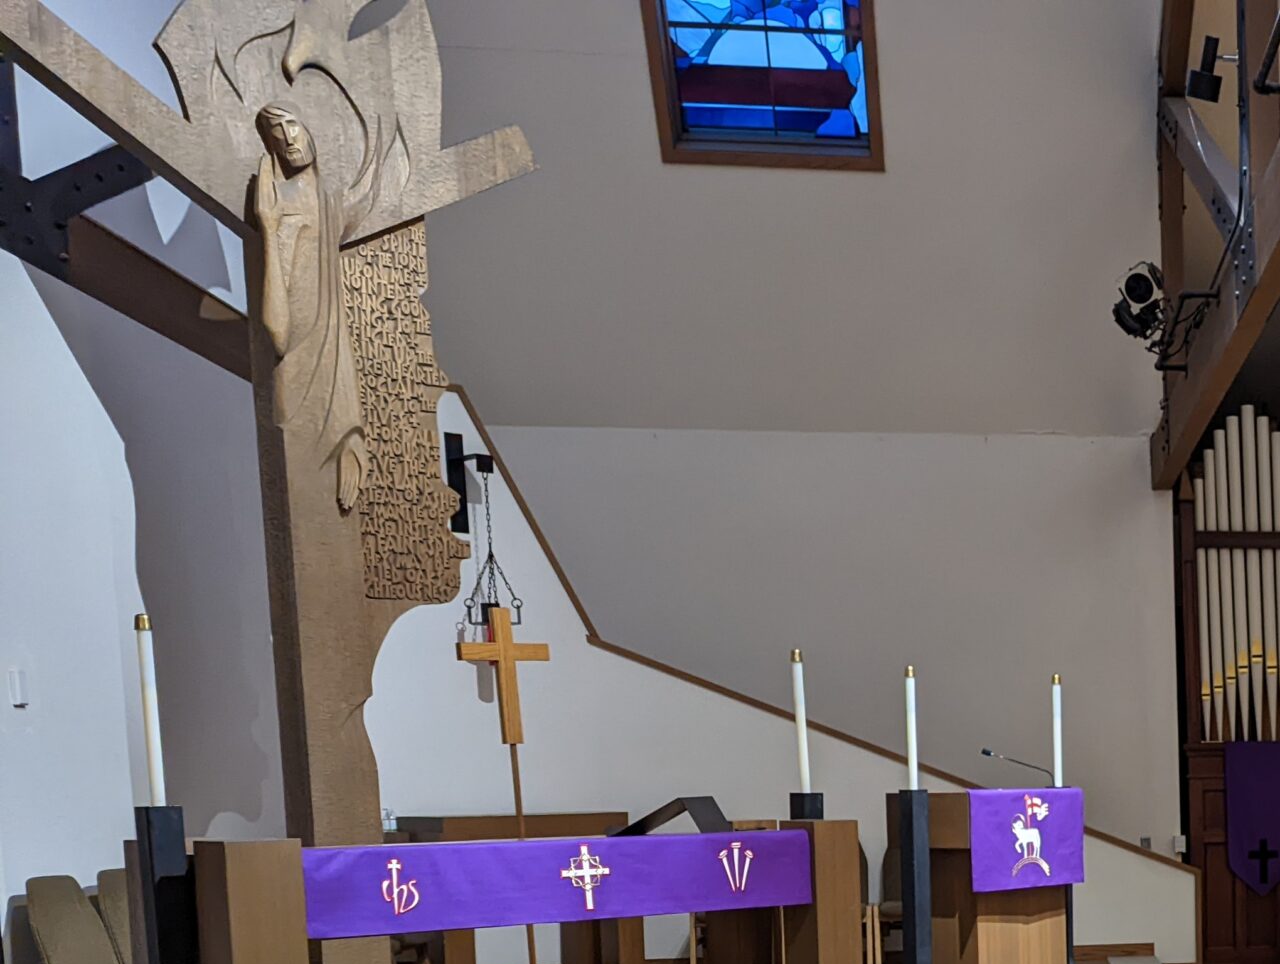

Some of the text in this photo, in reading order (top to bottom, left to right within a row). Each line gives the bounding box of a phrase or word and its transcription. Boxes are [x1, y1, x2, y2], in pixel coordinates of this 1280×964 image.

[380, 232, 426, 257] SPIRIT
[343, 256, 383, 280] UPON
[358, 244, 376, 263] OF
[395, 251, 426, 273] LORD
[391, 299, 431, 320] GOOD
